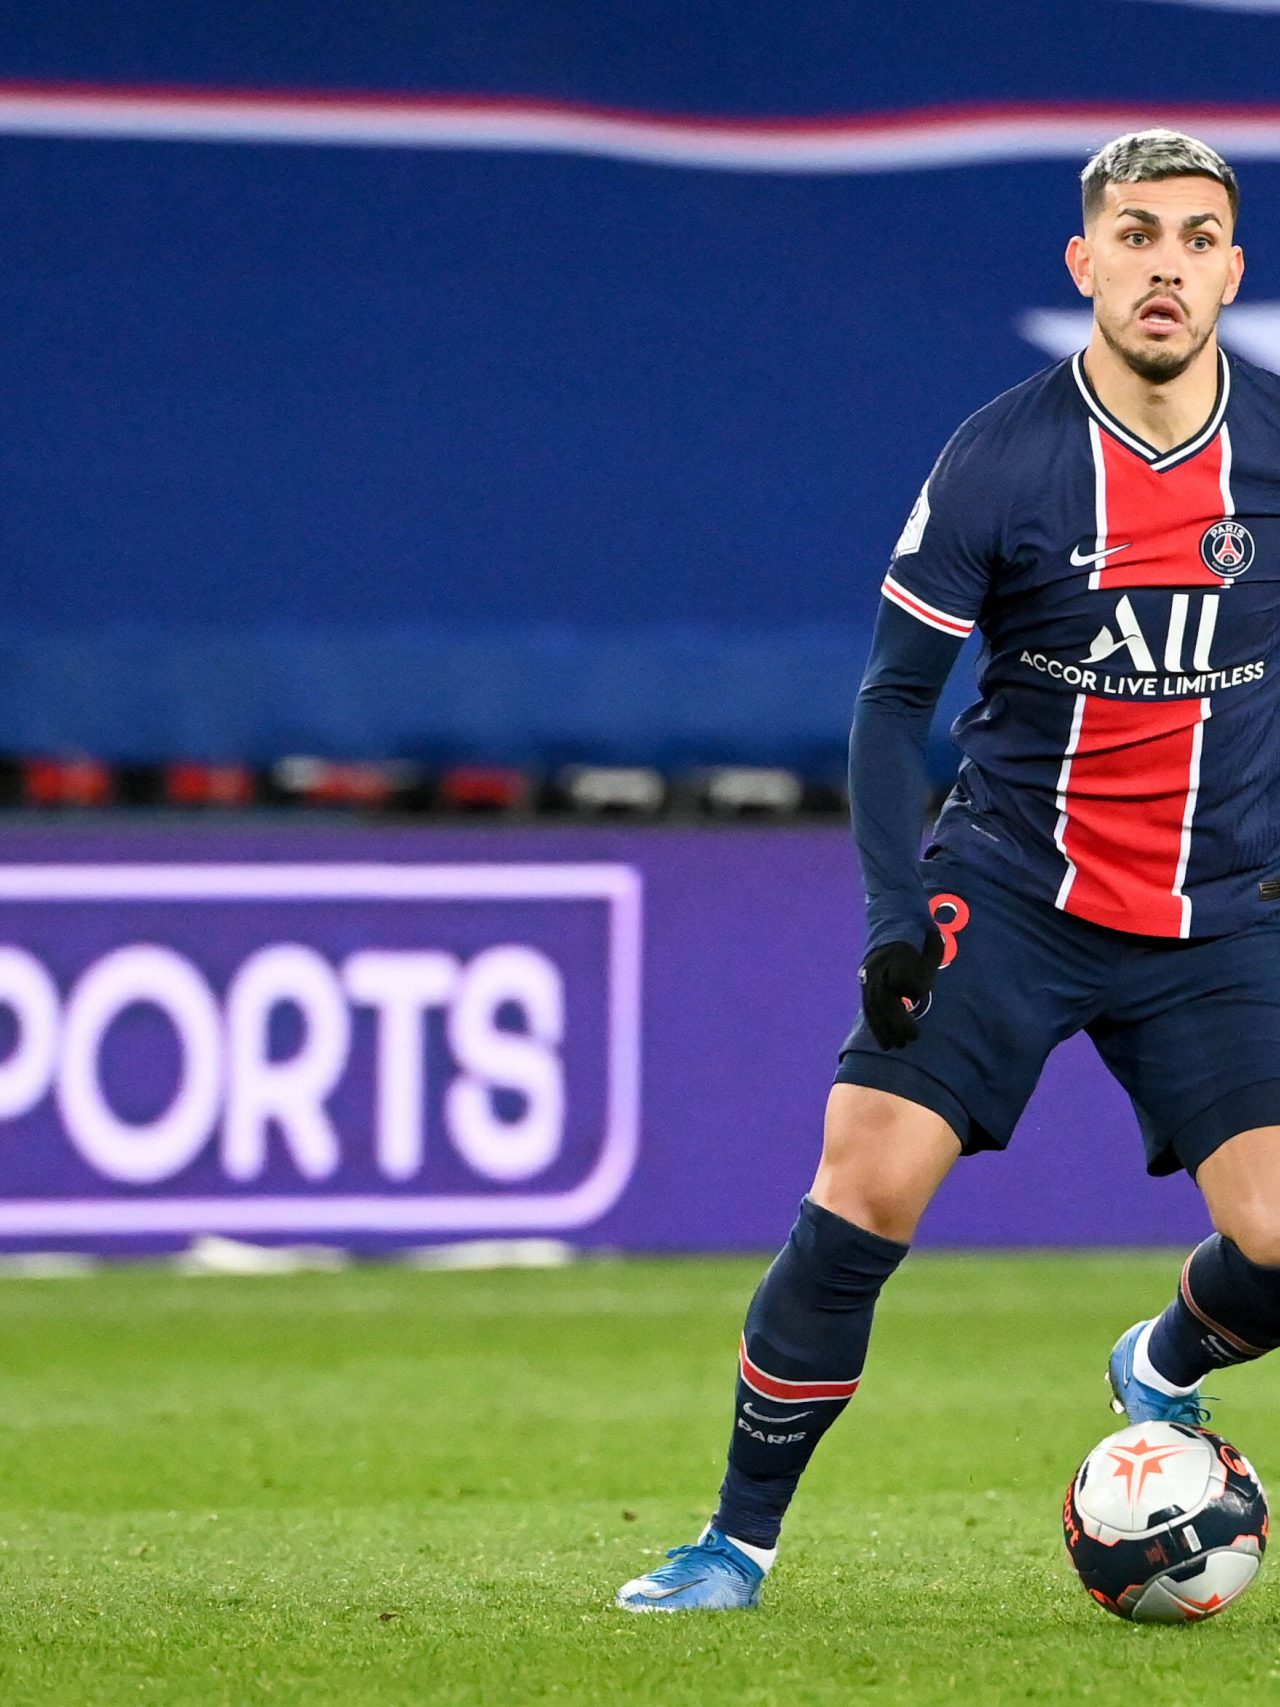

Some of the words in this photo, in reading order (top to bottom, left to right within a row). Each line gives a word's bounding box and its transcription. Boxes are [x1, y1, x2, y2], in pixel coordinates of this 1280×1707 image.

[1210, 524, 1245, 538] PARIS
[1020, 650, 1097, 691] ACCOR
[1104, 676, 1158, 696] LIVE
[1163, 660, 1265, 696] LIMITLESS
[738, 1417, 807, 1445] PARIS
